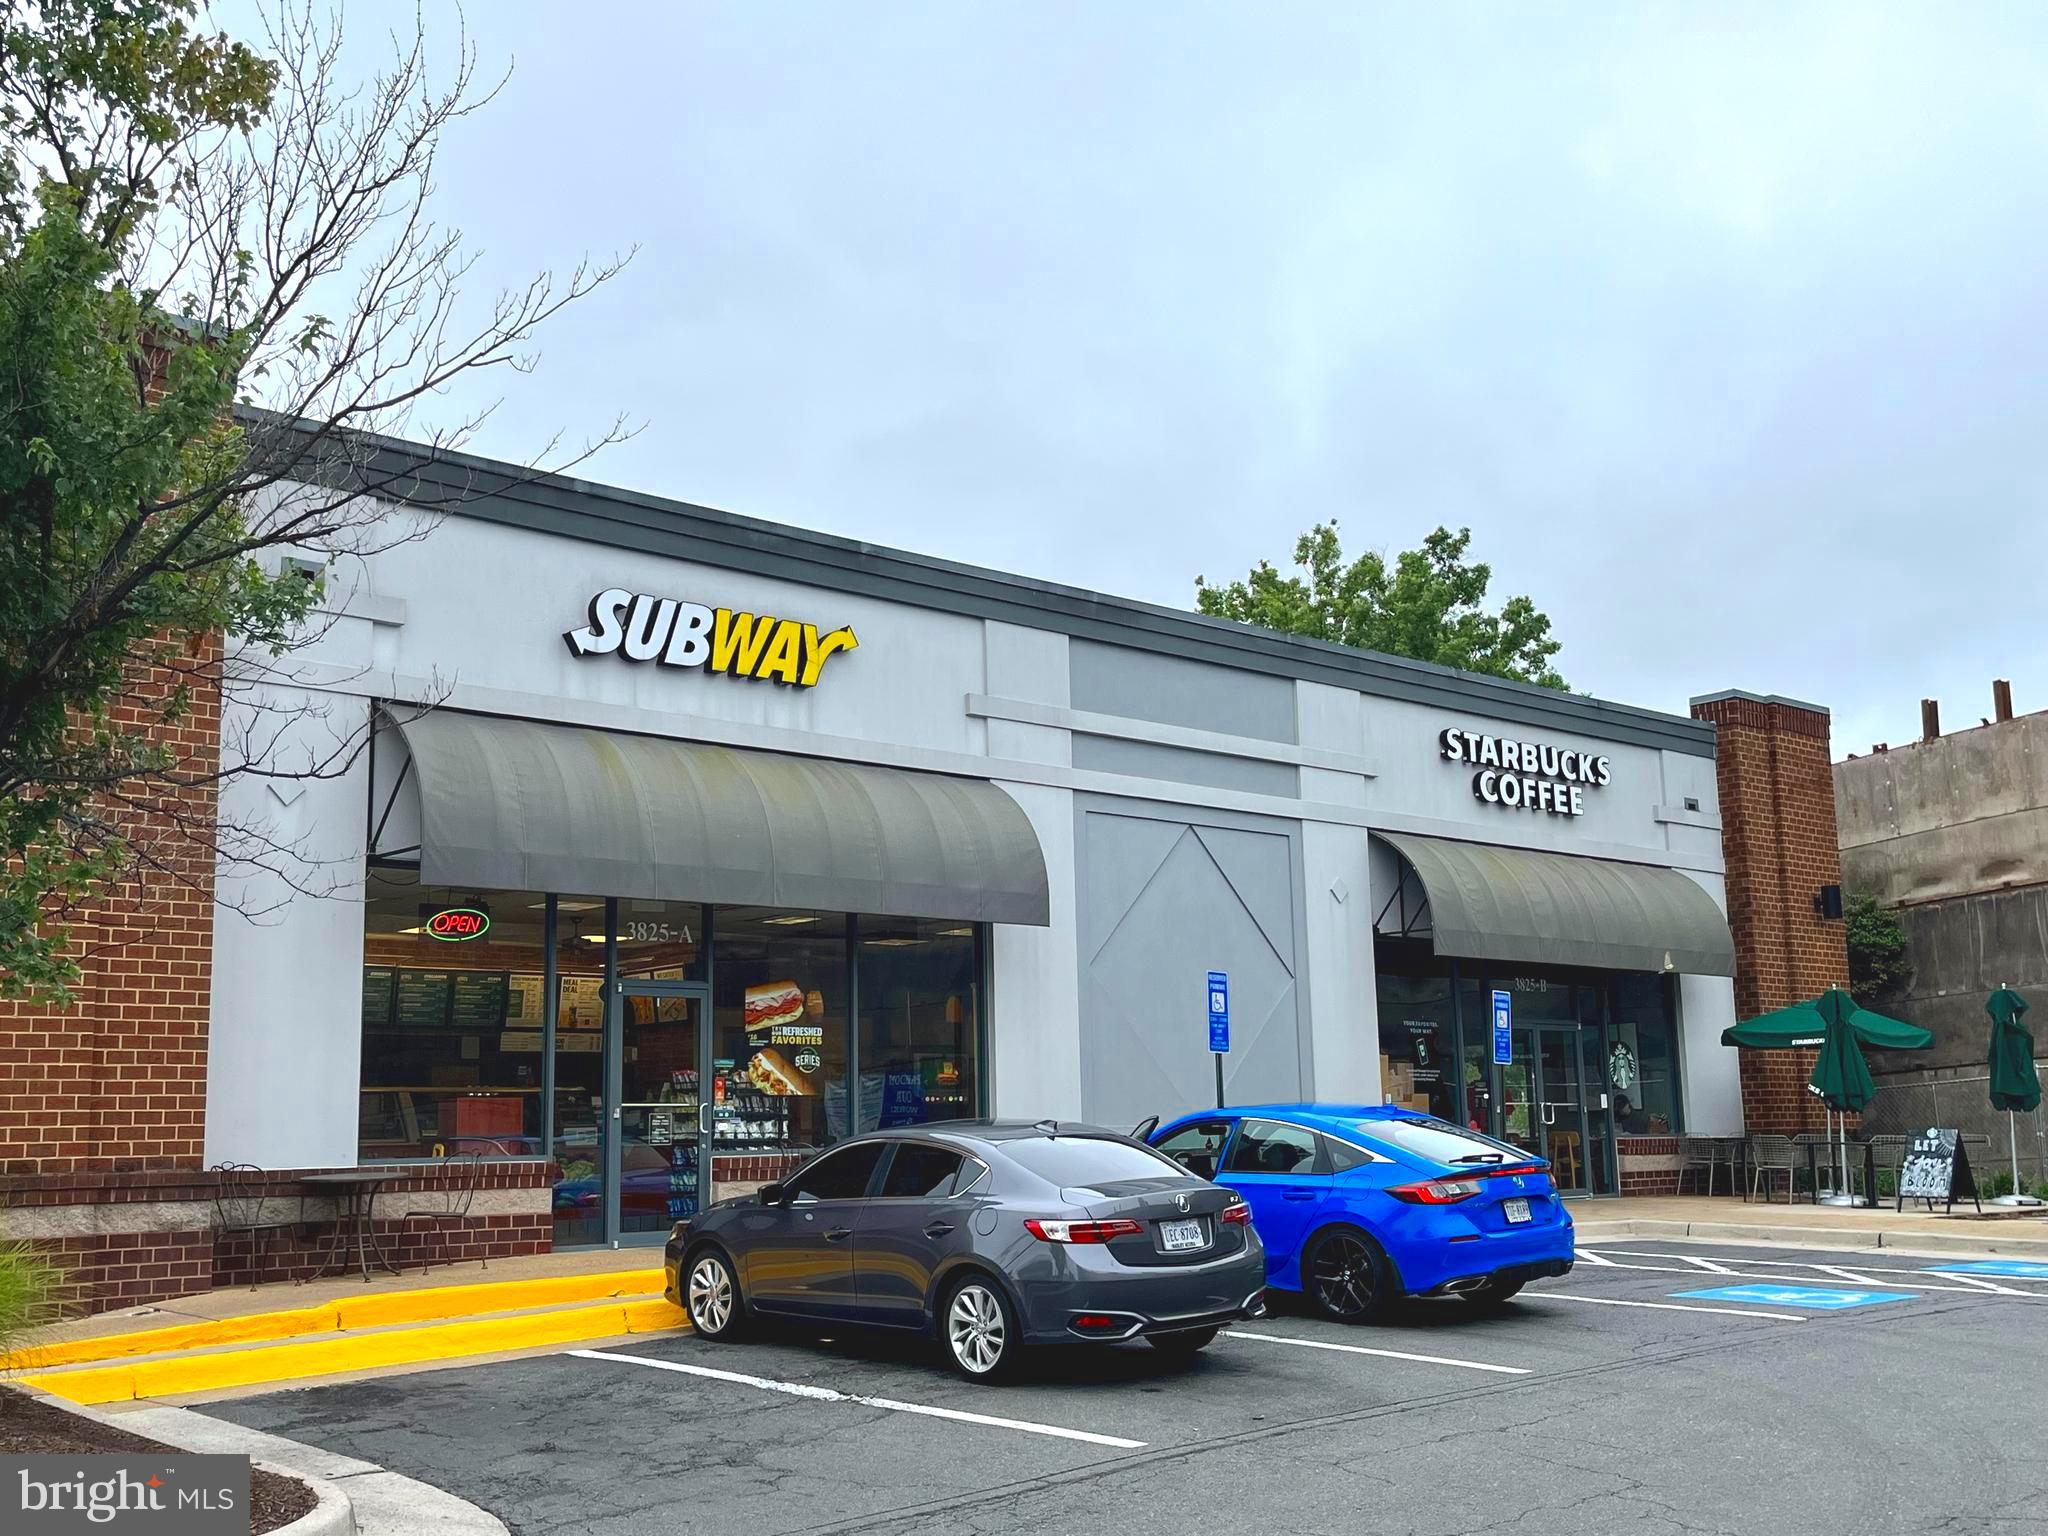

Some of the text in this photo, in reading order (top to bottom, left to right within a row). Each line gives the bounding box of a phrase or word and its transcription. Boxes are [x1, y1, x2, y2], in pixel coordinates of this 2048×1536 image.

[563, 588, 859, 688] SUBWAY
[1440, 727, 1611, 786] STARBUCKS
[1473, 770, 1583, 816] COFFEE
[433, 914, 481, 933] OPEN
[626, 921, 693, 943] 3825-A
[771, 1036, 823, 1045] FAVORITES
[782, 1026, 823, 1037] REFRESHED
[795, 1054, 821, 1067] SERIES
[1914, 1139, 1939, 1152] LET
